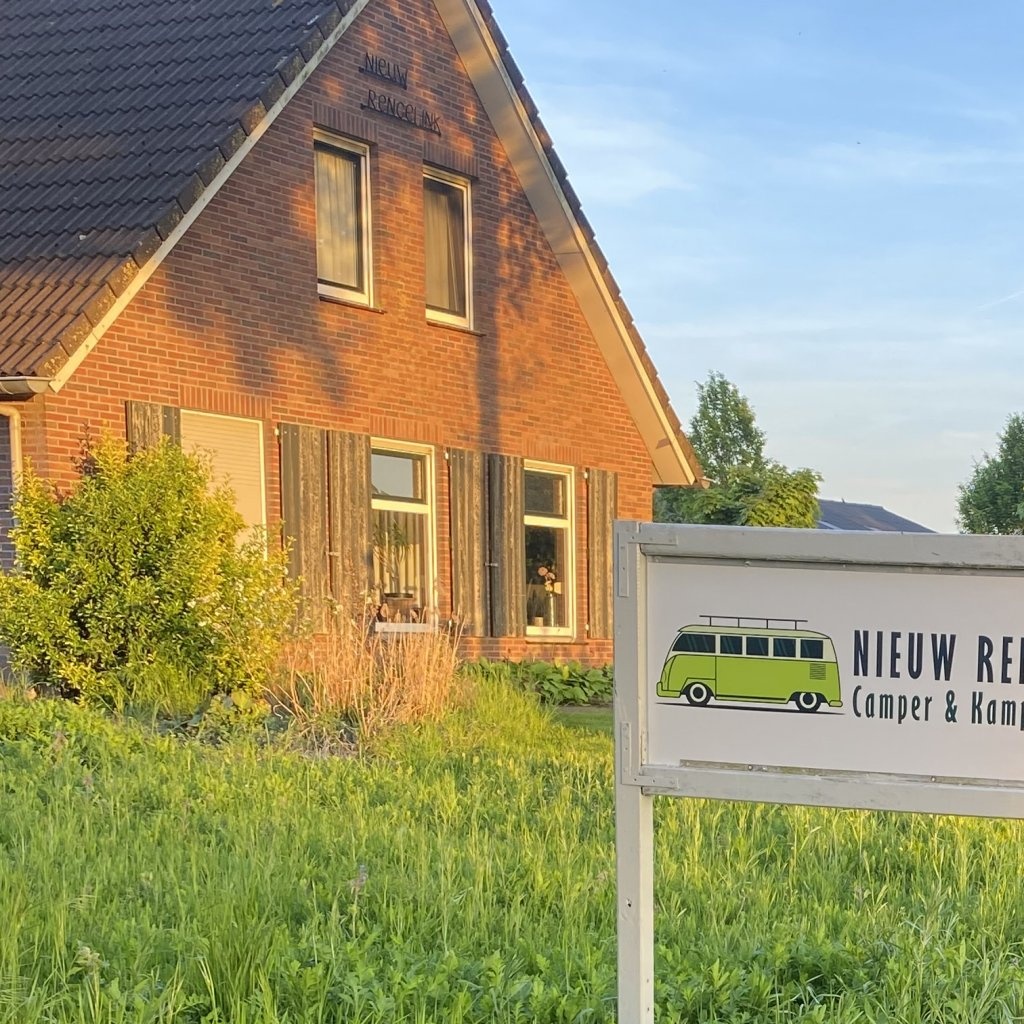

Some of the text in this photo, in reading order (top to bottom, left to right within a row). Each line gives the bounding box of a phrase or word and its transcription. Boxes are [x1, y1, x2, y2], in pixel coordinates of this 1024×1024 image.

[853, 629, 957, 681] NIEUW
[852, 684, 933, 725] Camper
[945, 689, 958, 723] &
